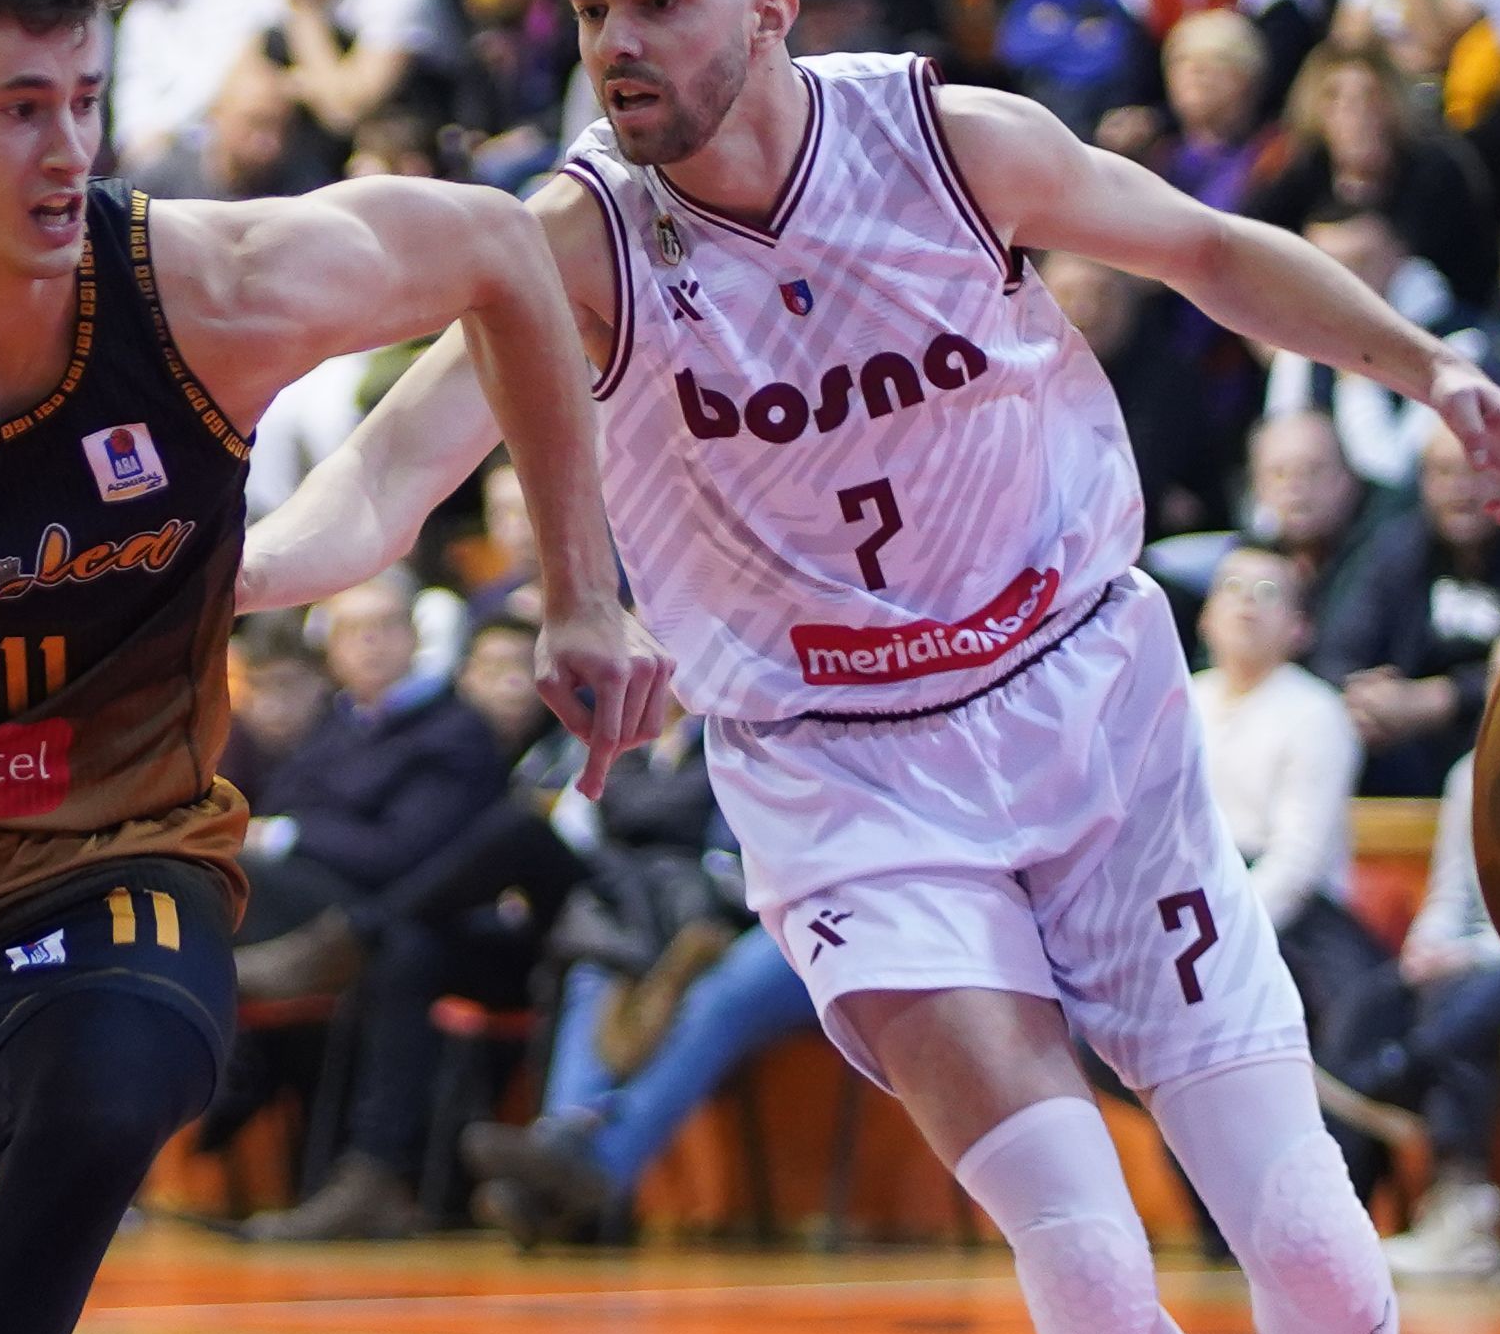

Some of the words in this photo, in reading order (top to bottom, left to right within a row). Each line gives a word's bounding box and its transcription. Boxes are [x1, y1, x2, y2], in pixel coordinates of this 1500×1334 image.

[673, 332, 990, 445] bosna
[836, 477, 905, 593] 7
[0, 635, 67, 718] 11
[104, 886, 180, 953] 11
[1156, 887, 1219, 1005] 7
